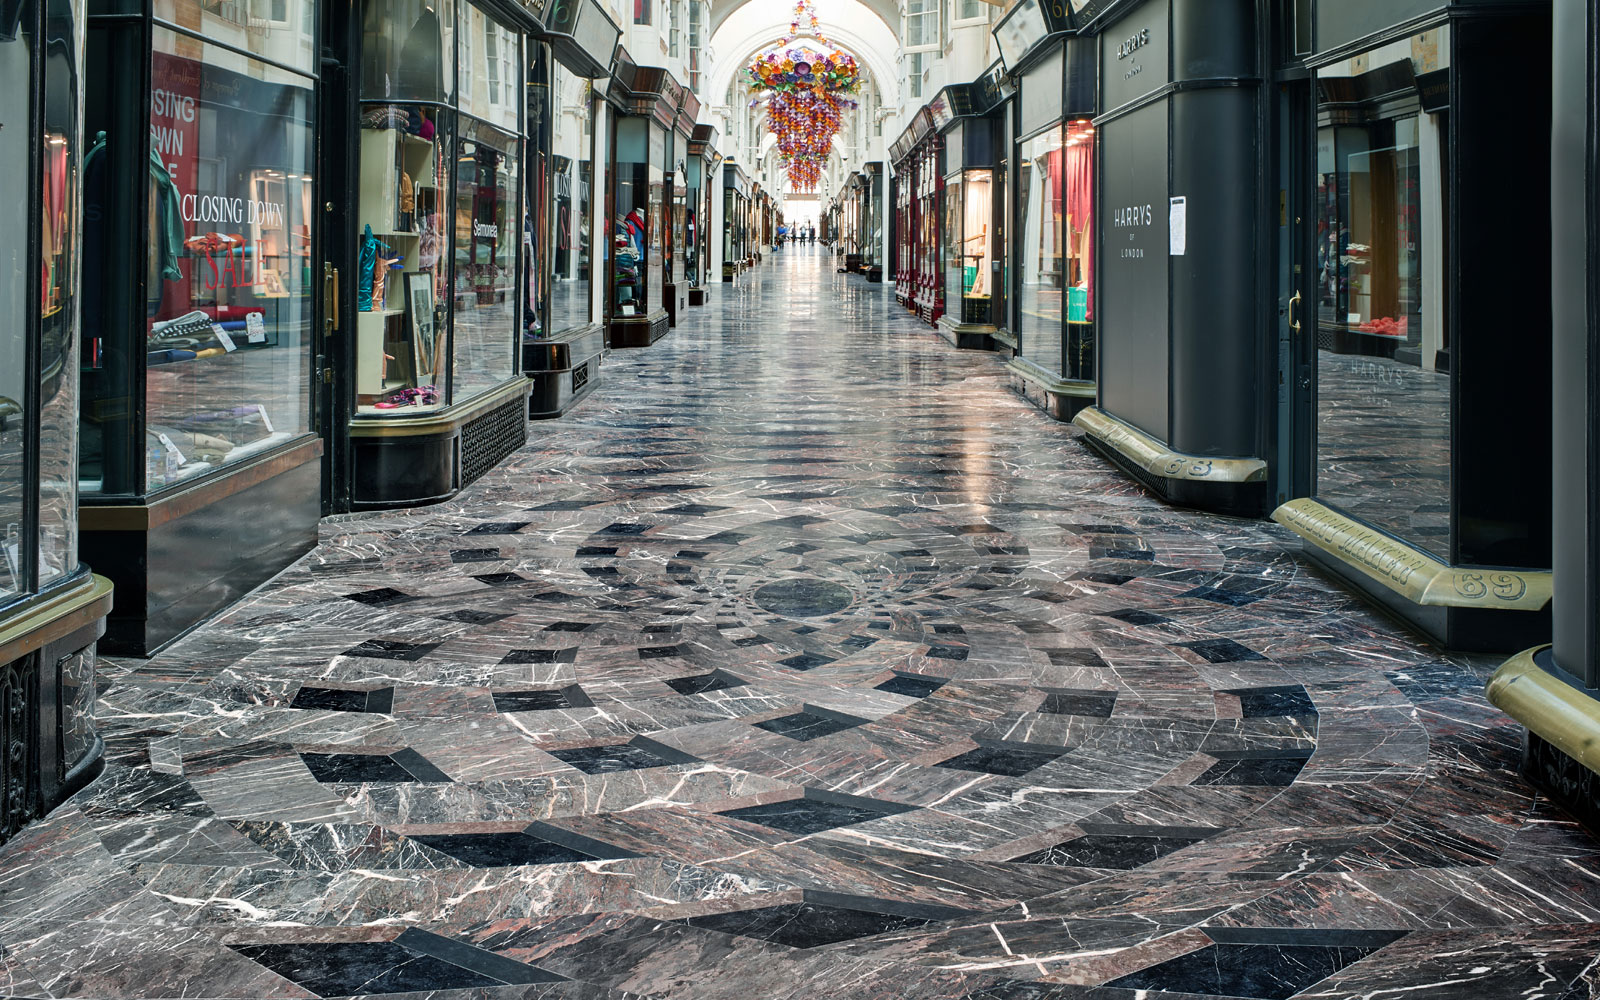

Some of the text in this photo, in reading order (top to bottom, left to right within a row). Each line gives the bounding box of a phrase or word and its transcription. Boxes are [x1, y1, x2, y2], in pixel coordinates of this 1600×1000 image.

[1117, 28, 1149, 60] HARRYS
[152, 88, 195, 123] SING
[182, 194, 284, 227] CLOSING DOWN
[1114, 204, 1152, 227] HARRYS
[560, 205, 584, 250] SALE
[205, 239, 268, 291] SALE
[1121, 248, 1144, 258] LONDON
[1351, 360, 1403, 385] HARRYS
[1164, 457, 1212, 477] 68
[1453, 573, 1527, 601] 69
